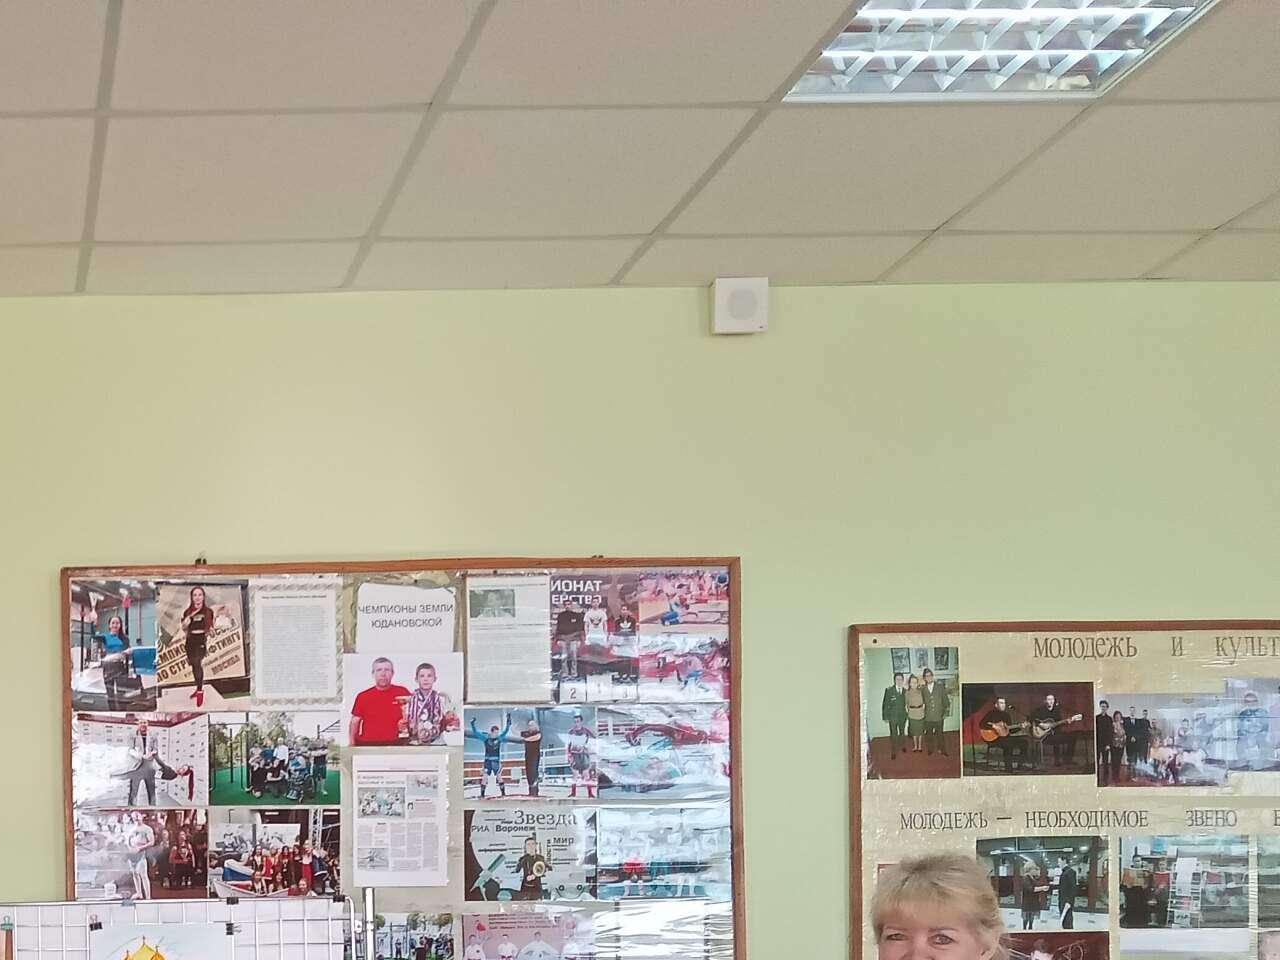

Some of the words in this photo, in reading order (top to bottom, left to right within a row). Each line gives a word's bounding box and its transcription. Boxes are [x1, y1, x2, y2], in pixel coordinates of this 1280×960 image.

[359, 604, 418, 615] ЧЕМПИОНЫ
[420, 603, 454, 614] ЗЕМЛИ
[371, 617, 443, 629] ЮДАНОВСКОЙ
[513, 809, 577, 826] Звезда
[899, 811, 988, 831] МОЛОДЕЖЬ
[1025, 810, 1148, 831] НЕОБХОДИМОЕ
